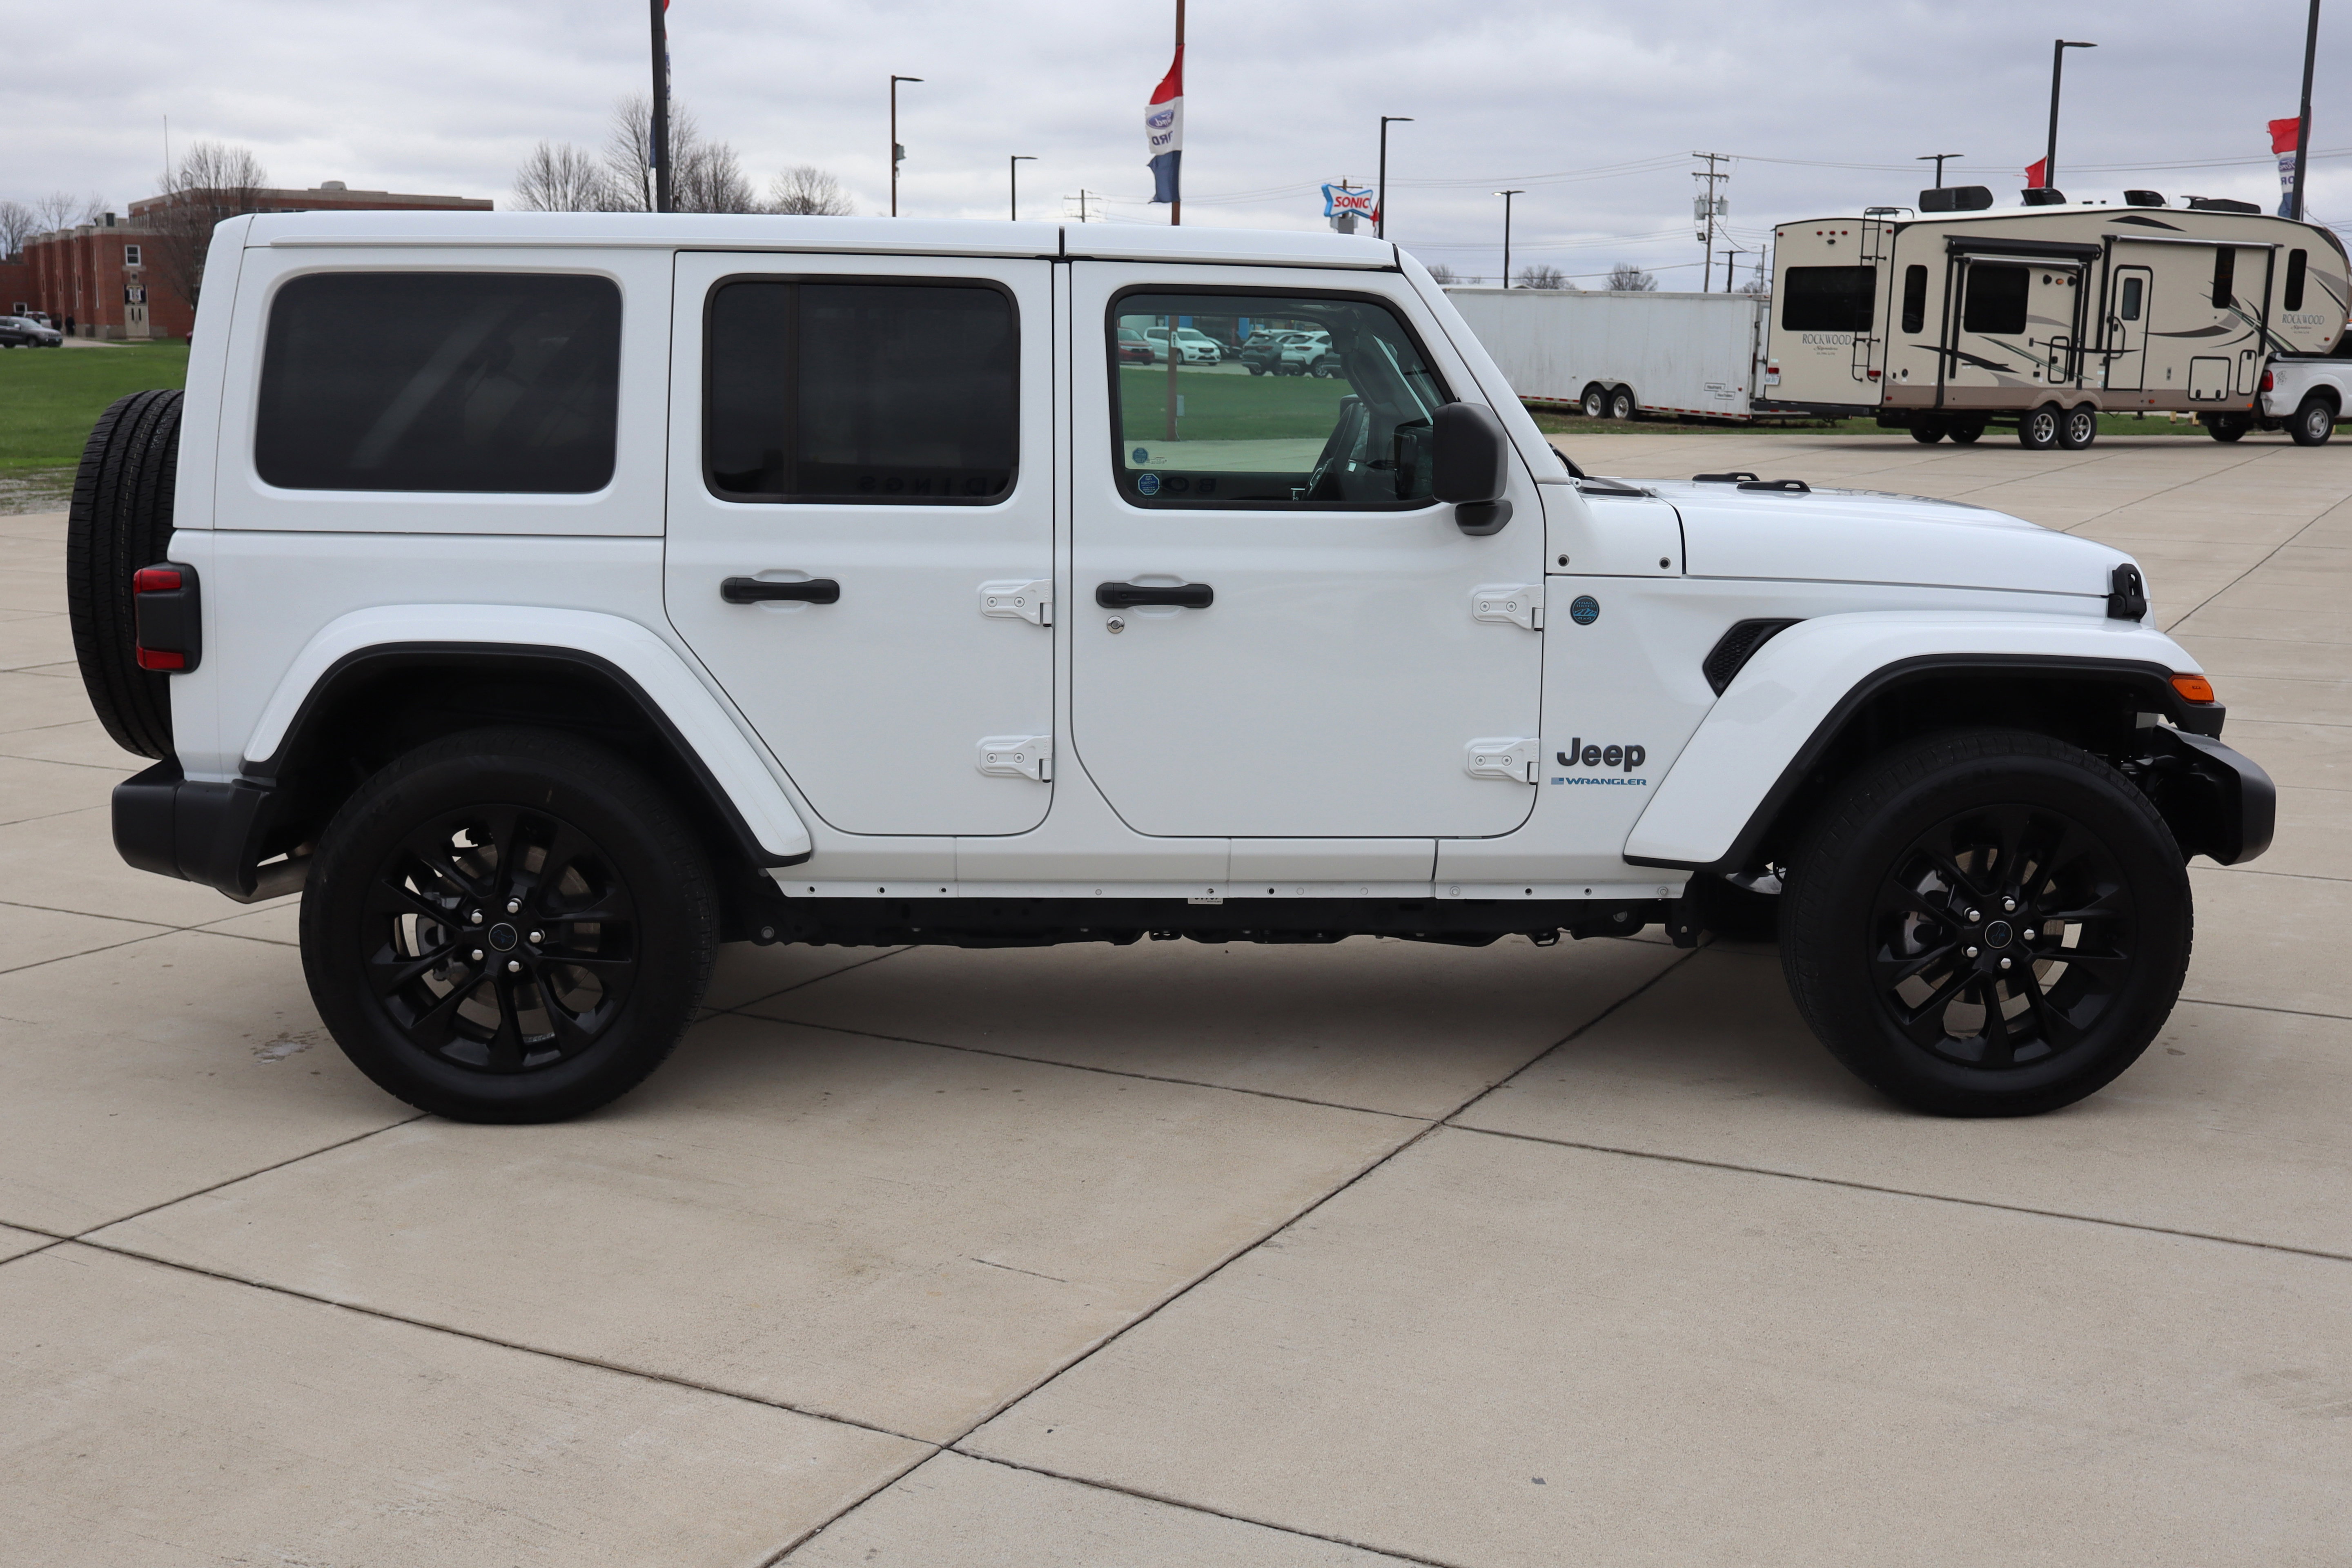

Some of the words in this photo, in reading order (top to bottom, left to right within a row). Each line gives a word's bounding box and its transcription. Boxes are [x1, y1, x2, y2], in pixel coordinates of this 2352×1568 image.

[1334, 196, 1370, 209] SONIC
[2282, 314, 2325, 325] ROCKWOOD
[1802, 334, 1851, 345] ROCKWOOD
[1557, 737, 1646, 772] Jeep
[1566, 777, 1647, 786] WRANGLER
